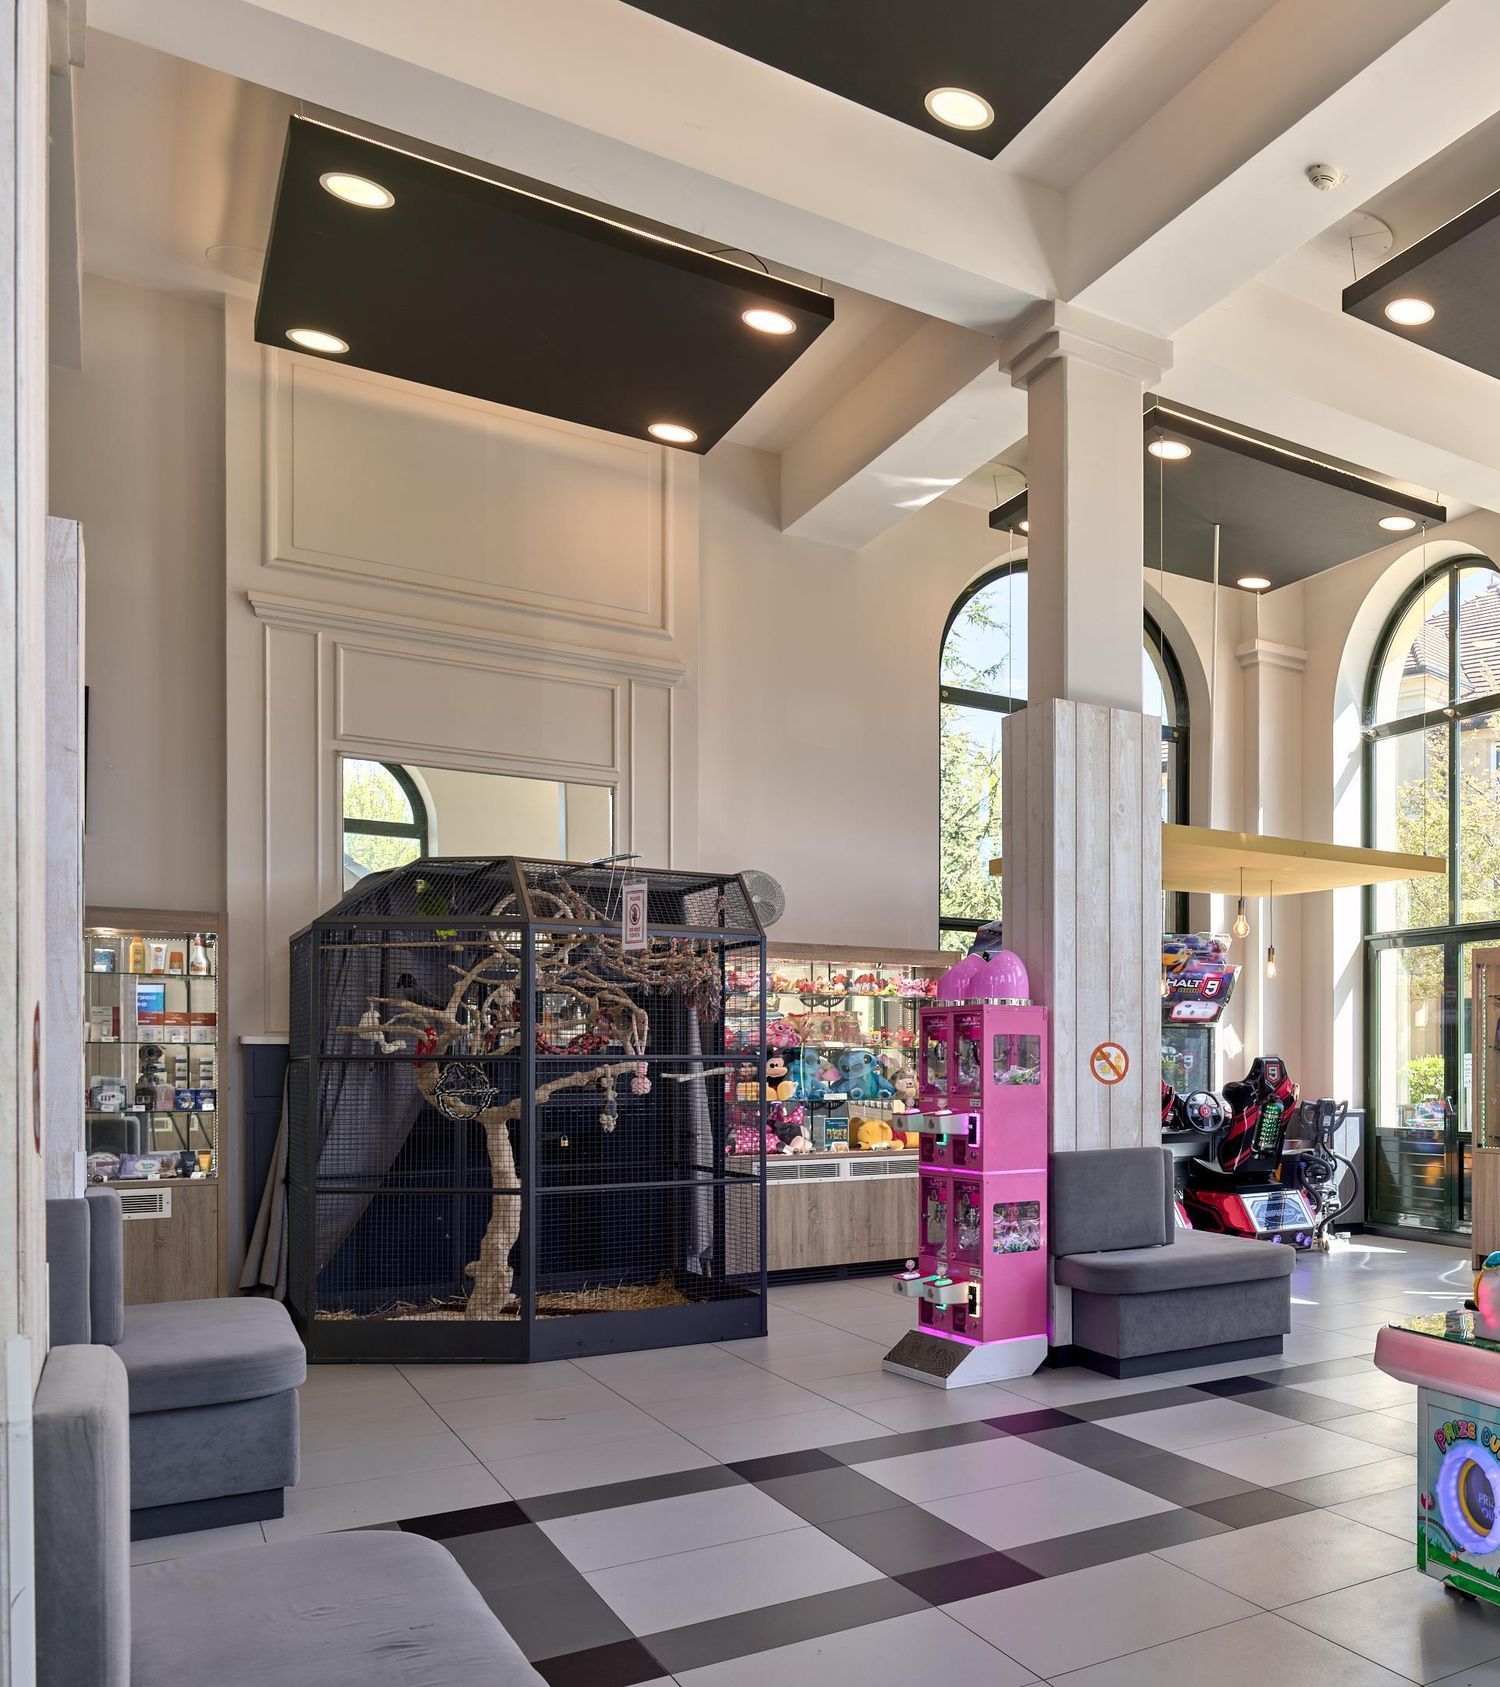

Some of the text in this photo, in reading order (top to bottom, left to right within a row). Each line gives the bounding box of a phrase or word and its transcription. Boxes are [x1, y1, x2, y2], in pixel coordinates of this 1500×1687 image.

[1205, 980, 1220, 996] 9
[1434, 1420, 1477, 1454] PRIZE
[1478, 1493, 1495, 1508] PRIZ
